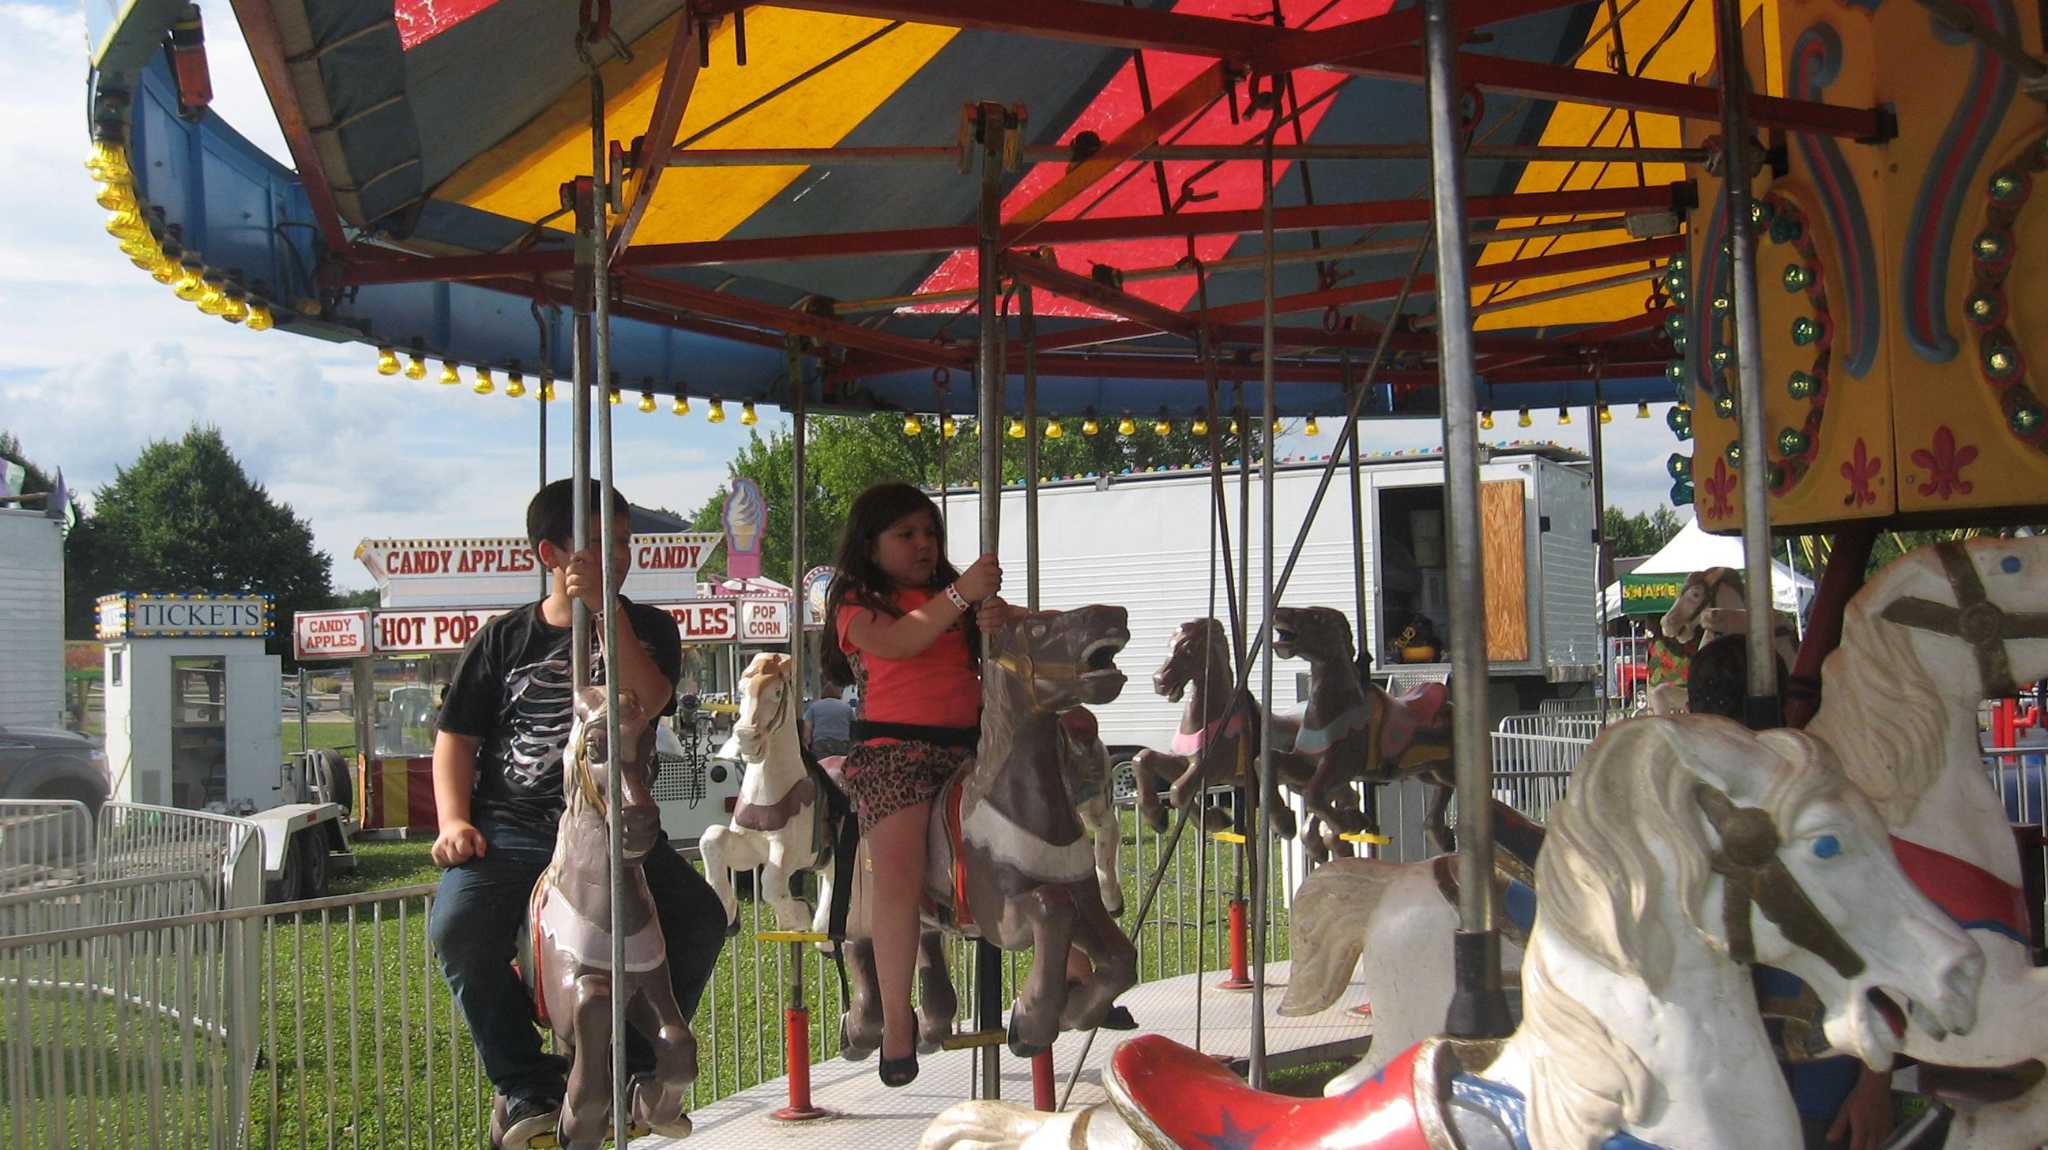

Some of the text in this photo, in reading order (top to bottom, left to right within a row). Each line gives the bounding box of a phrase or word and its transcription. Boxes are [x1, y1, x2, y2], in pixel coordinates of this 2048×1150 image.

[386, 548, 535, 575] CANDY APPLES
[638, 545, 701, 569] CANDY
[140, 604, 260, 627] TICKETS
[670, 607, 729, 636] PLES
[752, 605, 777, 618] POP
[309, 618, 352, 634] CANDY
[380, 615, 479, 646] HOT POP
[749, 621, 781, 635] CORN
[306, 634, 357, 649] APPLES
